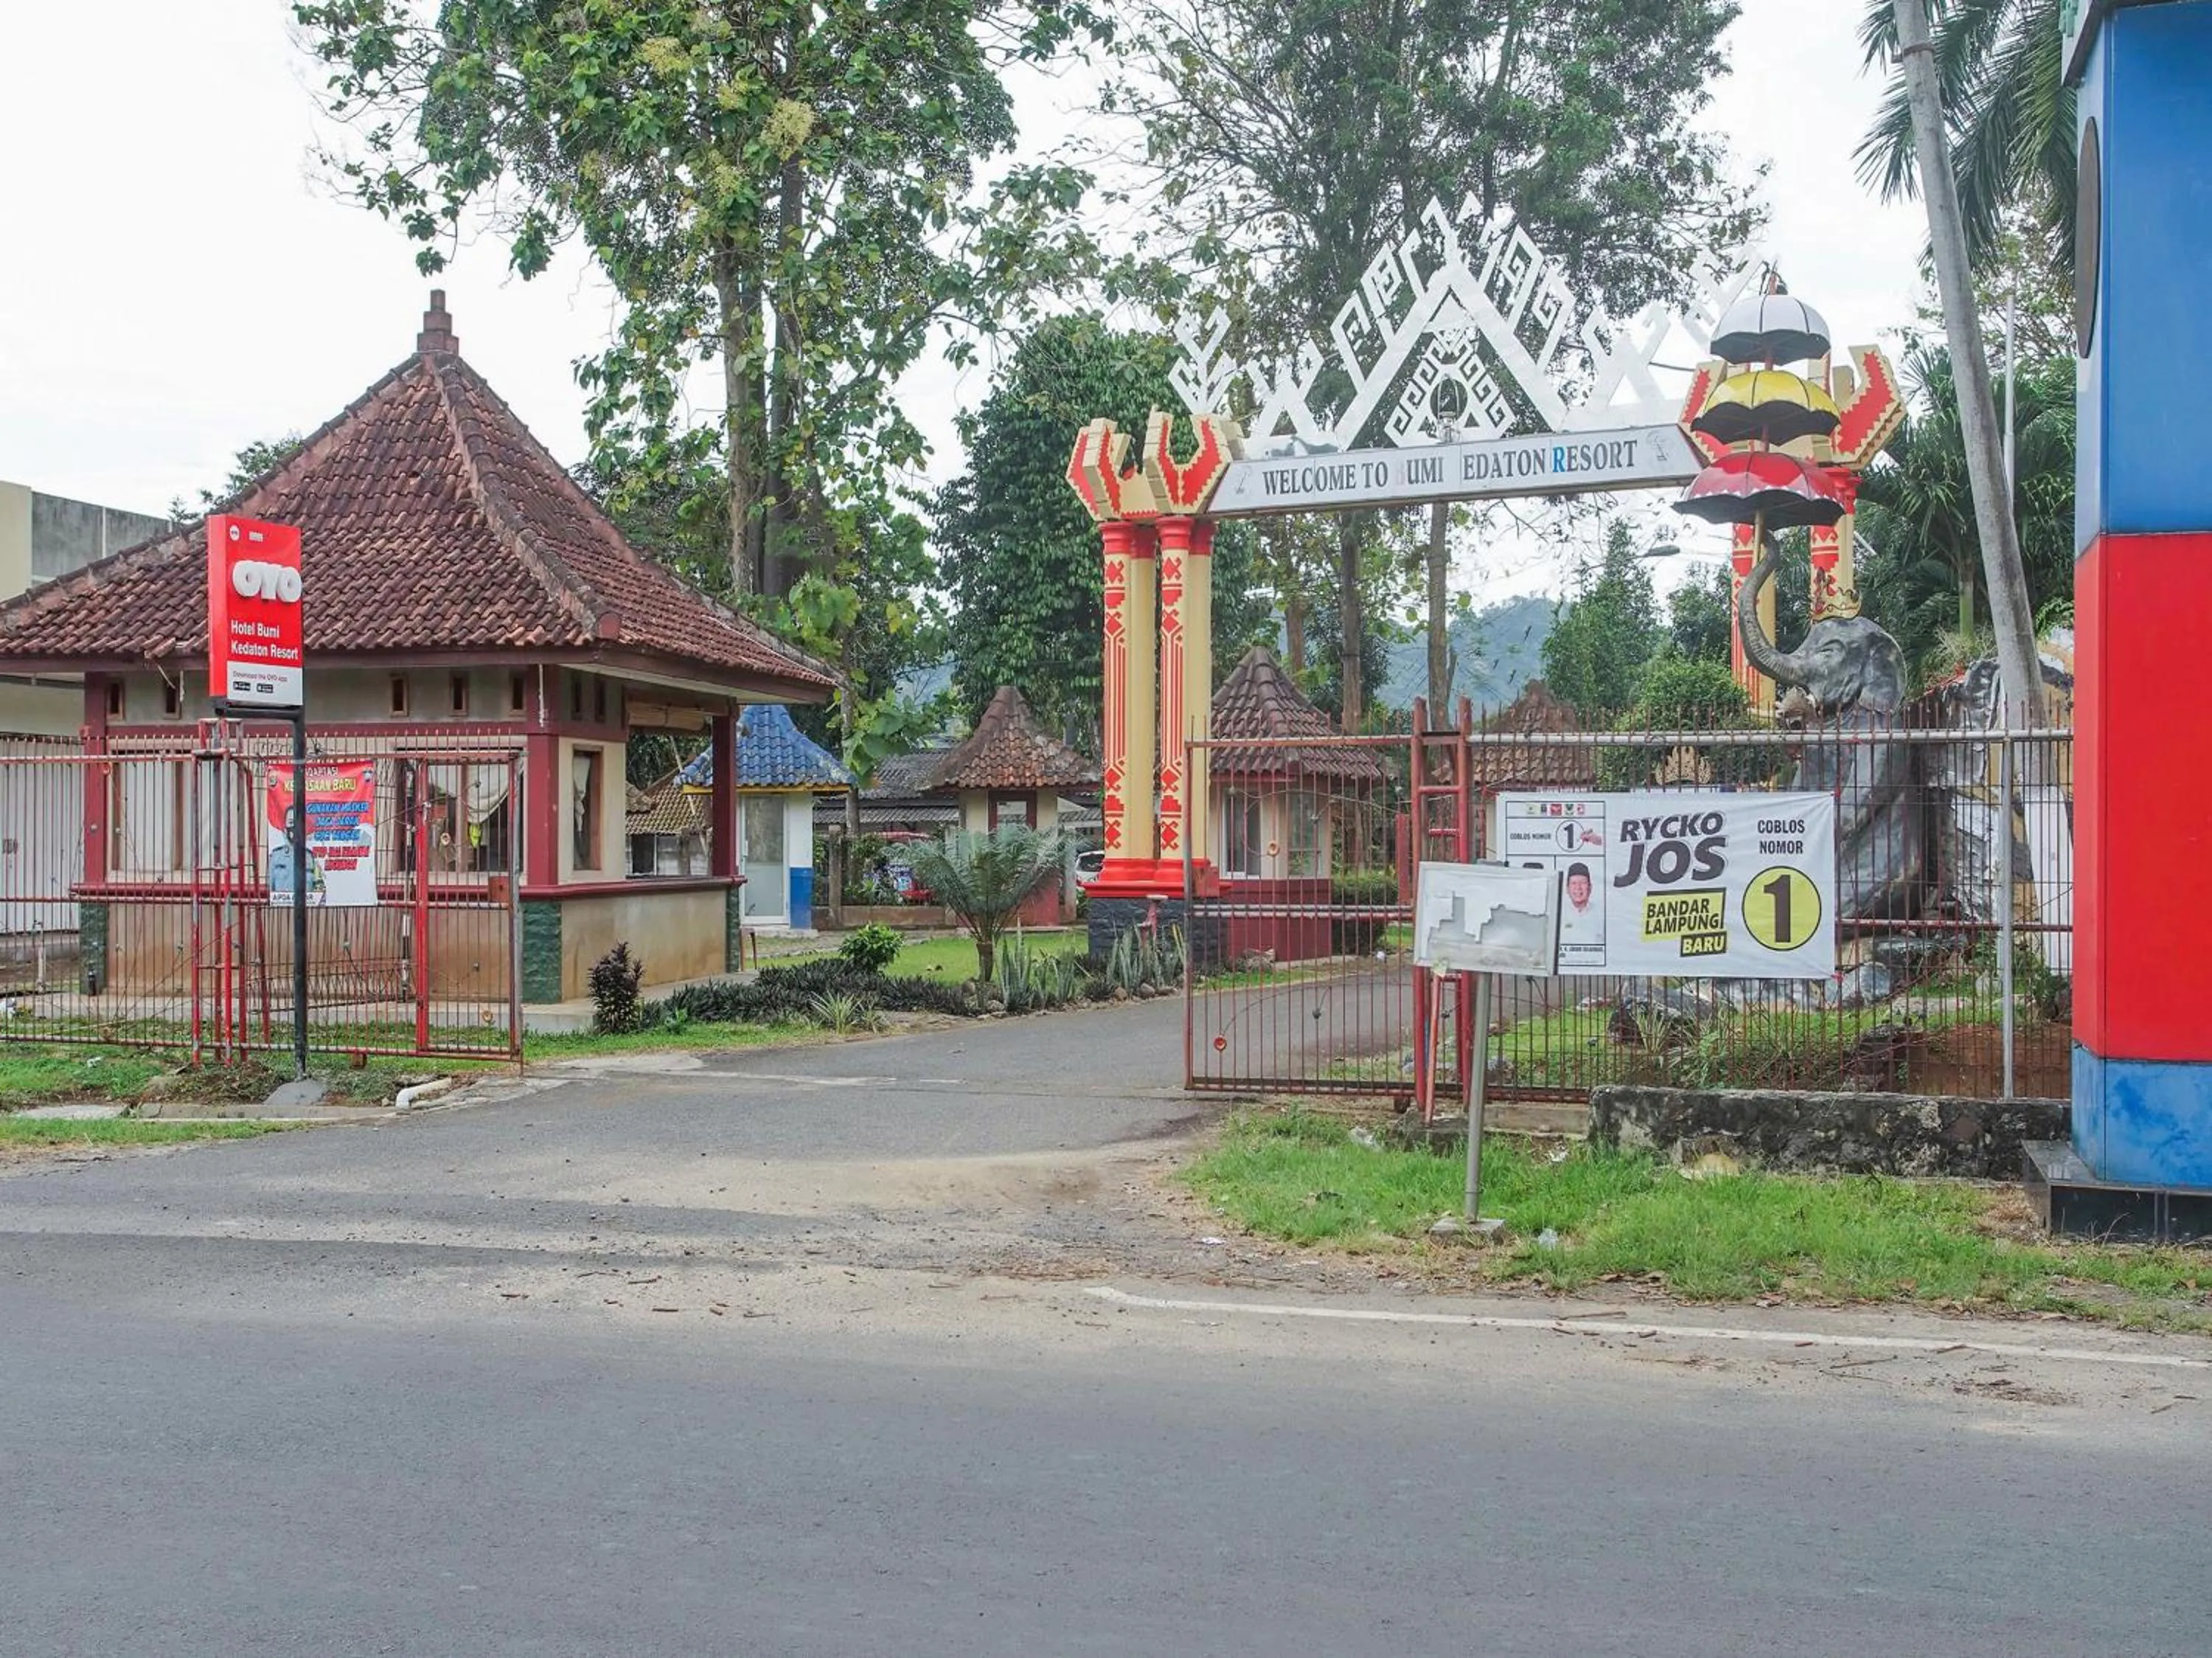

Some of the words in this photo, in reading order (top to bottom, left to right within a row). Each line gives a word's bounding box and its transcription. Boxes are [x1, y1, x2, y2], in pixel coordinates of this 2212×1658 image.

[1262, 463, 1356, 496] WELCOME
[1361, 461, 1388, 488] TO
[1397, 456, 1444, 485] UMI
[1551, 440, 1638, 474] RESORT
[232, 560, 302, 603] OYO
[231, 620, 255, 636] Hotel
[257, 622, 279, 639] Bumi
[231, 639, 268, 657] Kedaton
[270, 643, 299, 660] Resort
[333, 777, 357, 791] BARU
[1564, 823, 1574, 849] 1
[1620, 812, 1724, 842] RYCKO
[1757, 819, 1805, 834] COBLOS
[1759, 840, 1804, 854] NOMOR
[1613, 837, 1727, 888] JOS
[1646, 898, 1710, 918] BANDAR
[1764, 874, 1791, 943] 1
[1645, 913, 1719, 934] LAMPUNG
[1683, 935, 1725, 954] BARU
